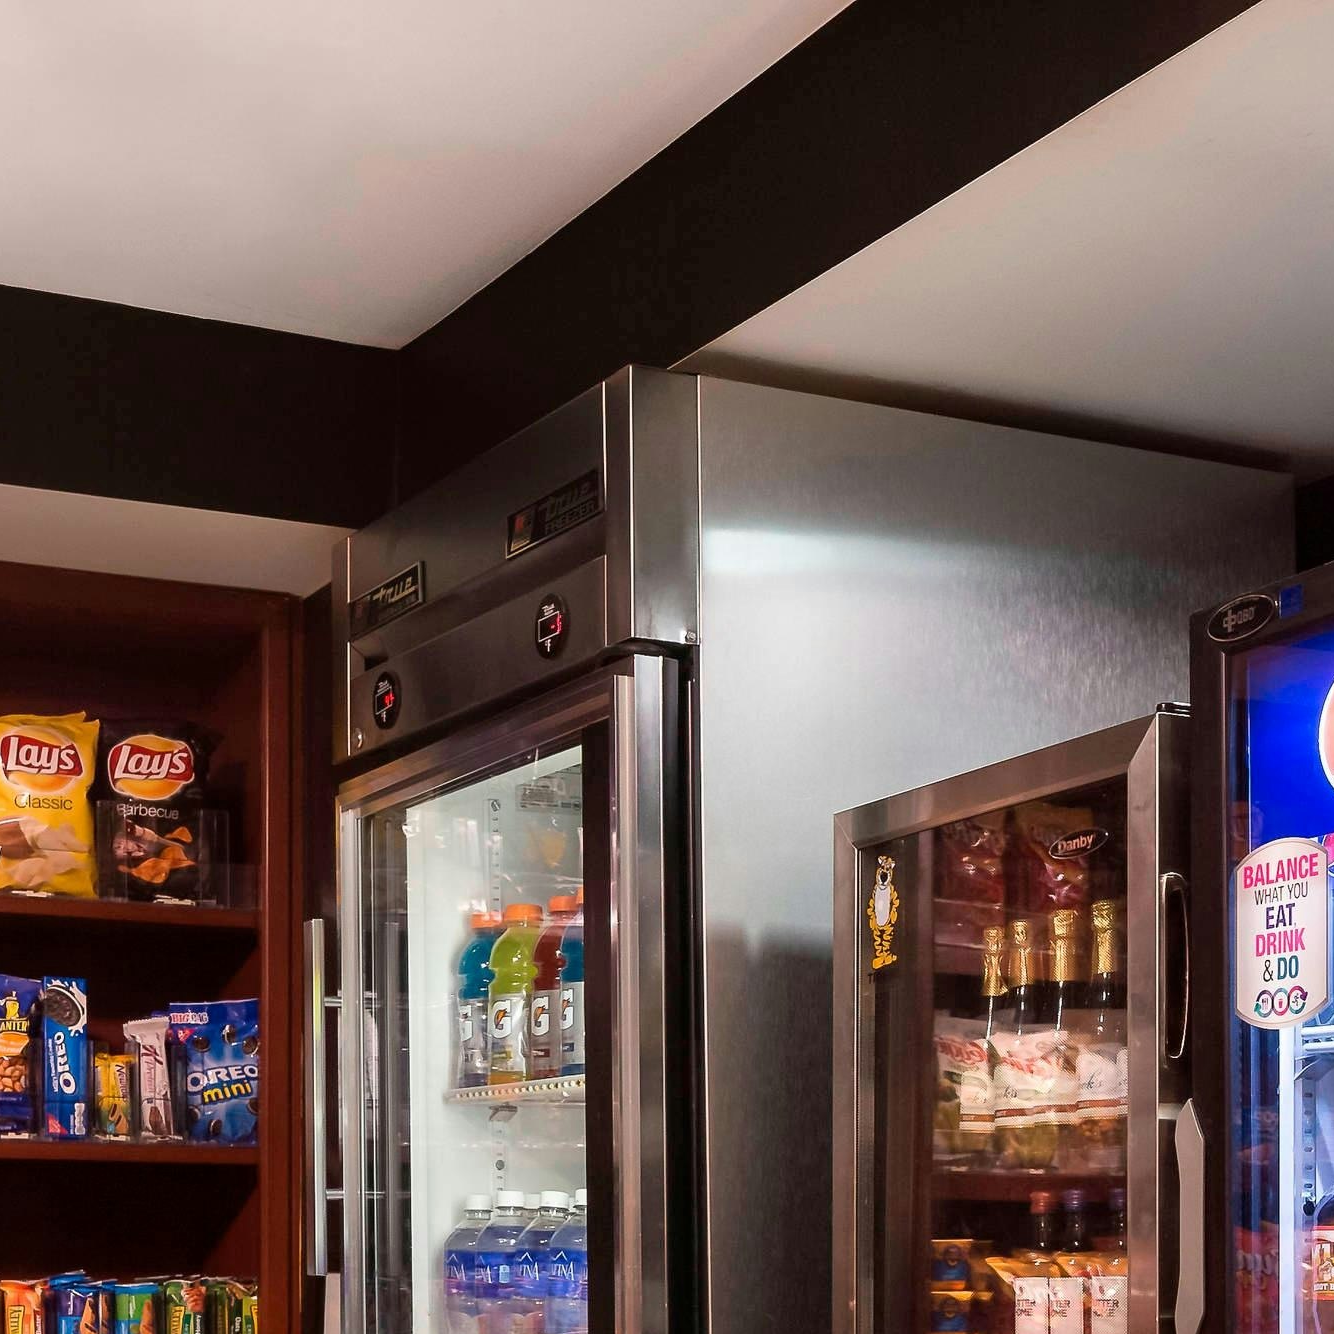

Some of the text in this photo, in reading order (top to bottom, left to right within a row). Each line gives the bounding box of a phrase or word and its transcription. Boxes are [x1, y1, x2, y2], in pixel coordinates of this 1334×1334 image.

[6, 737, 76, 775] Lay's
[114, 745, 189, 780] Lay's
[14, 793, 73, 811] Classic
[117, 802, 180, 820] Barbecue
[1058, 833, 1096, 854] Danby
[1243, 853, 1319, 890] BALANCE
[1254, 882, 1309, 906] WHAT YOU
[1255, 927, 1306, 958] DRINK
[1263, 955, 1300, 982] & DO
[171, 1012, 190, 1024] BIG
[53, 1031, 77, 1095] OREO
[186, 1064, 259, 1092] OREO
[202, 1079, 253, 1104] mini
